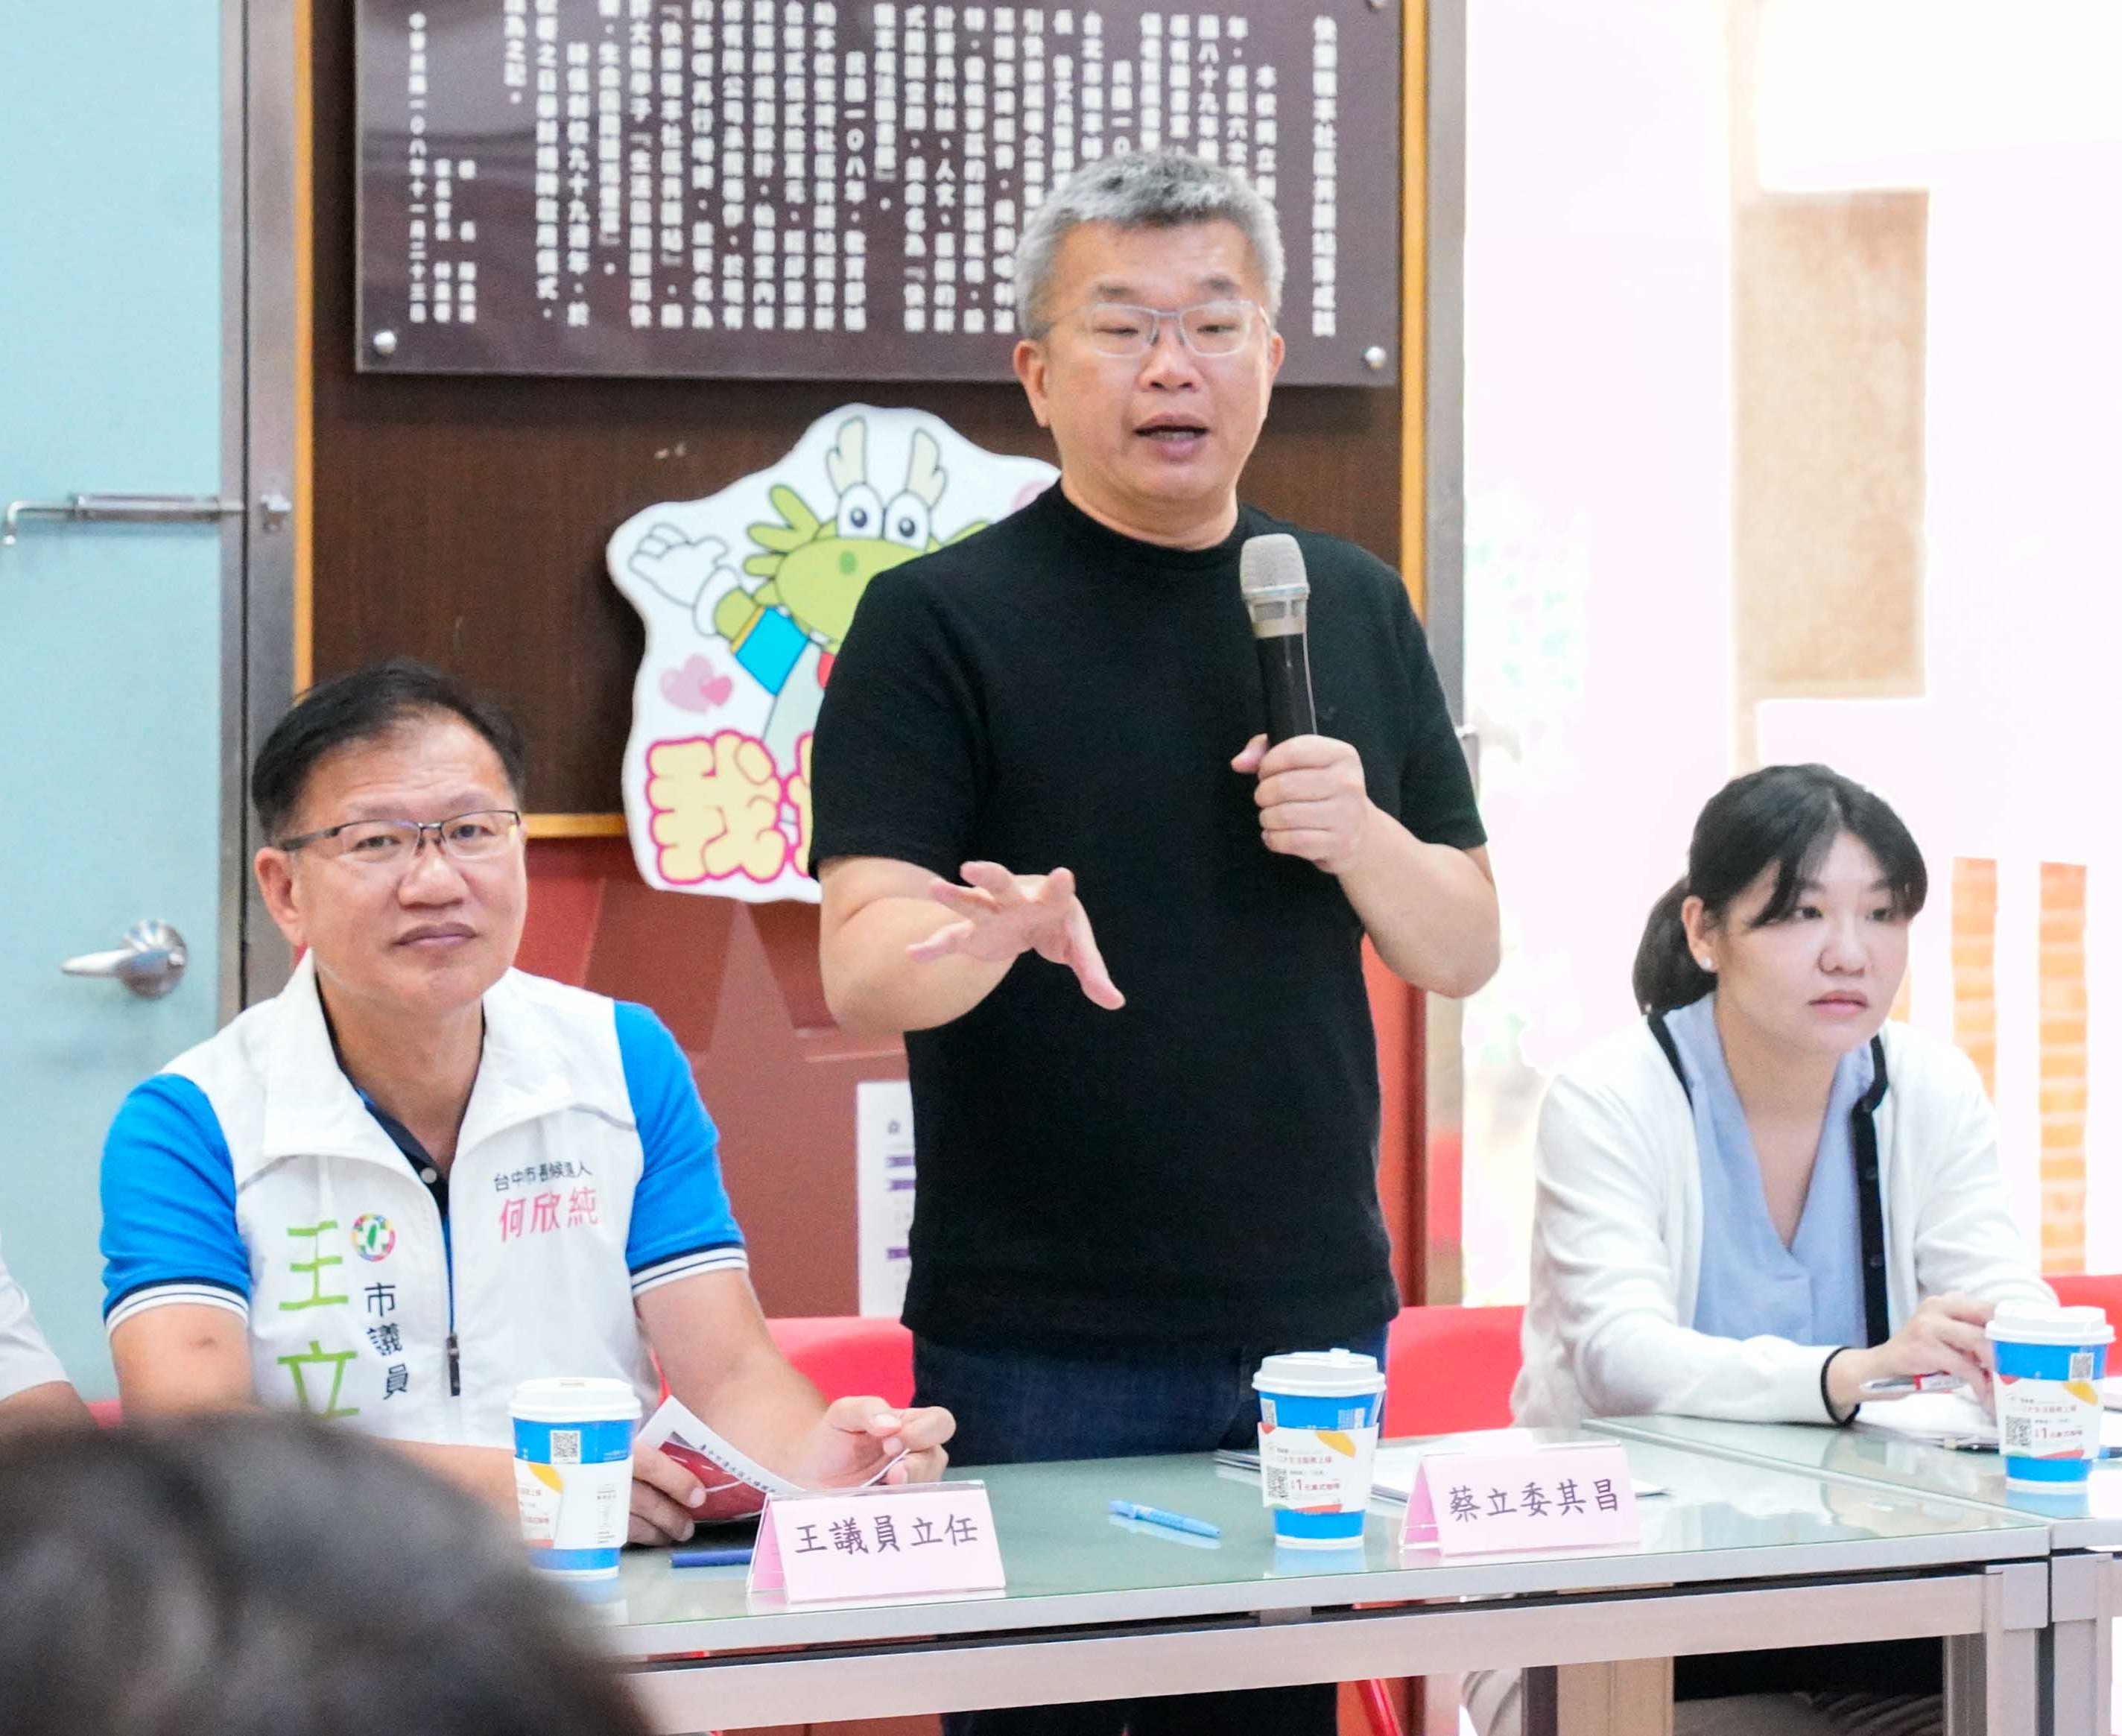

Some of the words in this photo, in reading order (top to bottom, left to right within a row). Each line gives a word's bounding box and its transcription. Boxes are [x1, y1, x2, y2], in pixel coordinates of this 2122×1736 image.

[646, 729, 812, 884] 我
[499, 1186, 599, 1243] 何欣純
[363, 1282, 411, 1401] 市議員
[1448, 1477, 1619, 1522] 蔡立委其昌
[794, 1512, 978, 1556] 王議員立任
